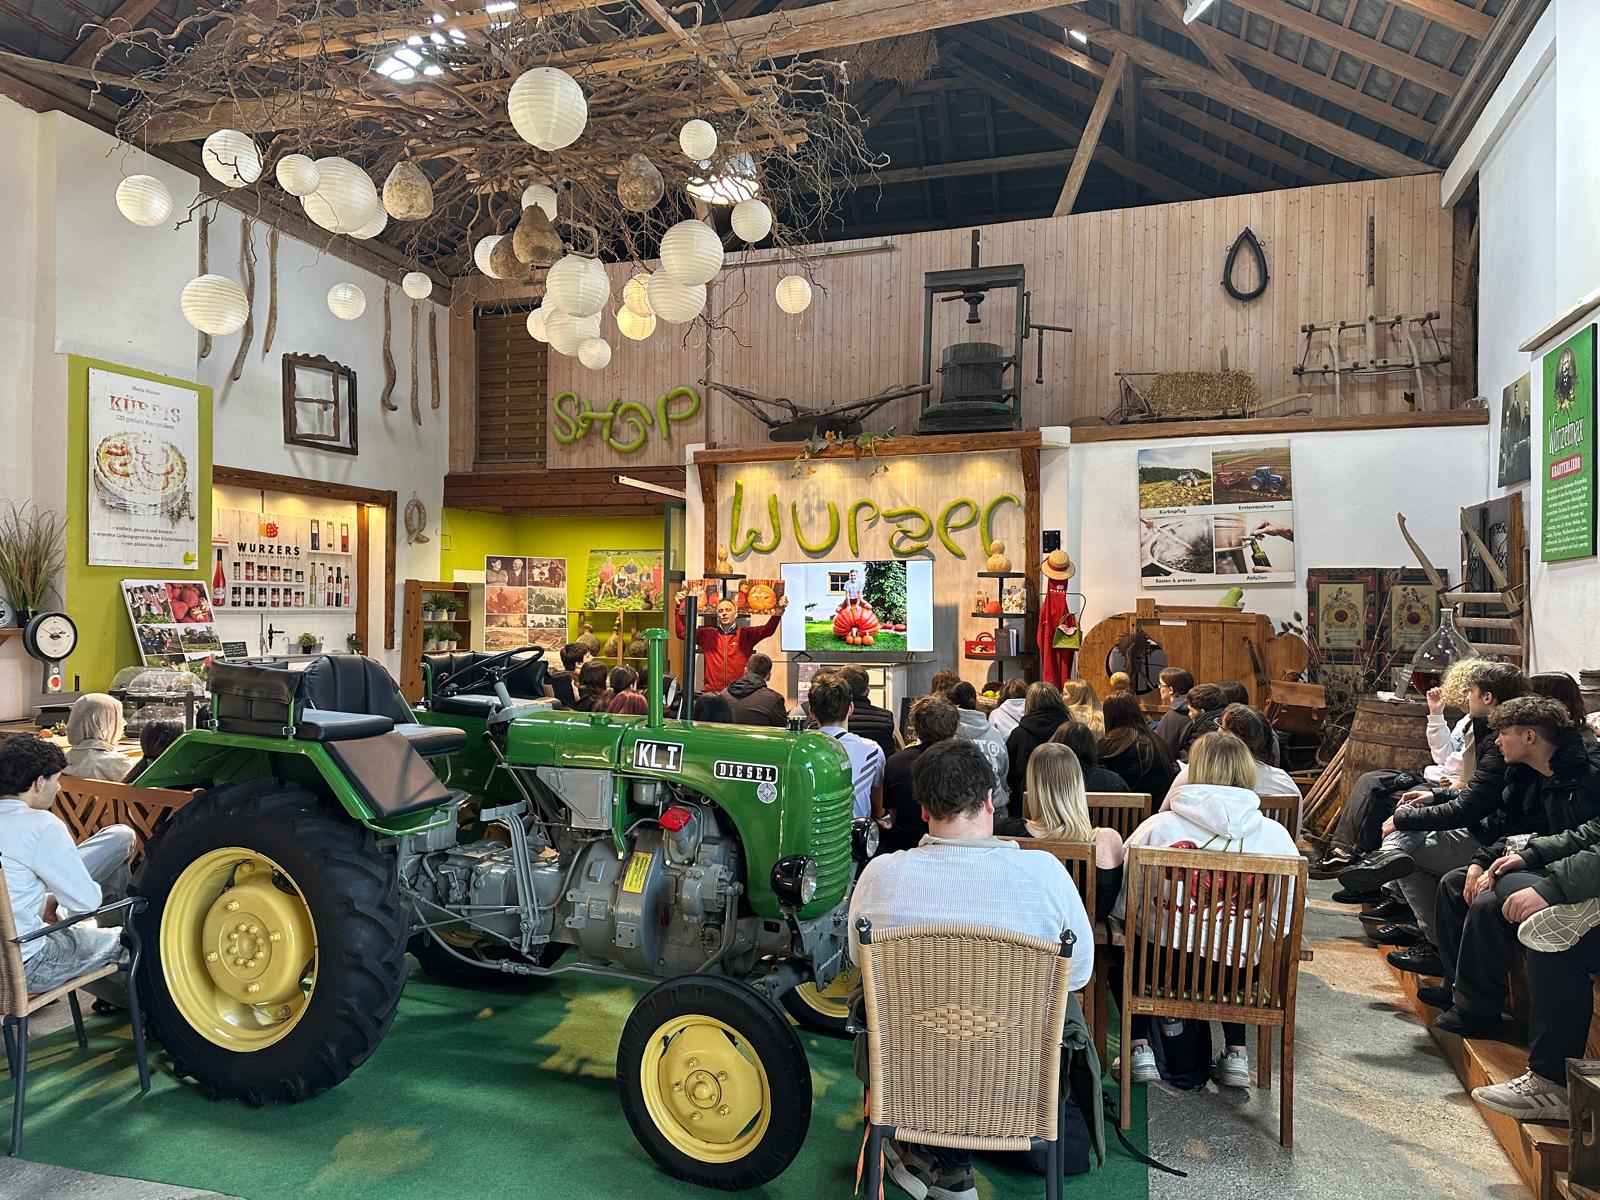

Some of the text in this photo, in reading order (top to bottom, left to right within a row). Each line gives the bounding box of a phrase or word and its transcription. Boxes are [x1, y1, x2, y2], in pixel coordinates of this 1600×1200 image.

[553, 386, 700, 453] SHOP
[237, 542, 300, 556] WURZERS
[719, 763, 772, 781] DIESEL
